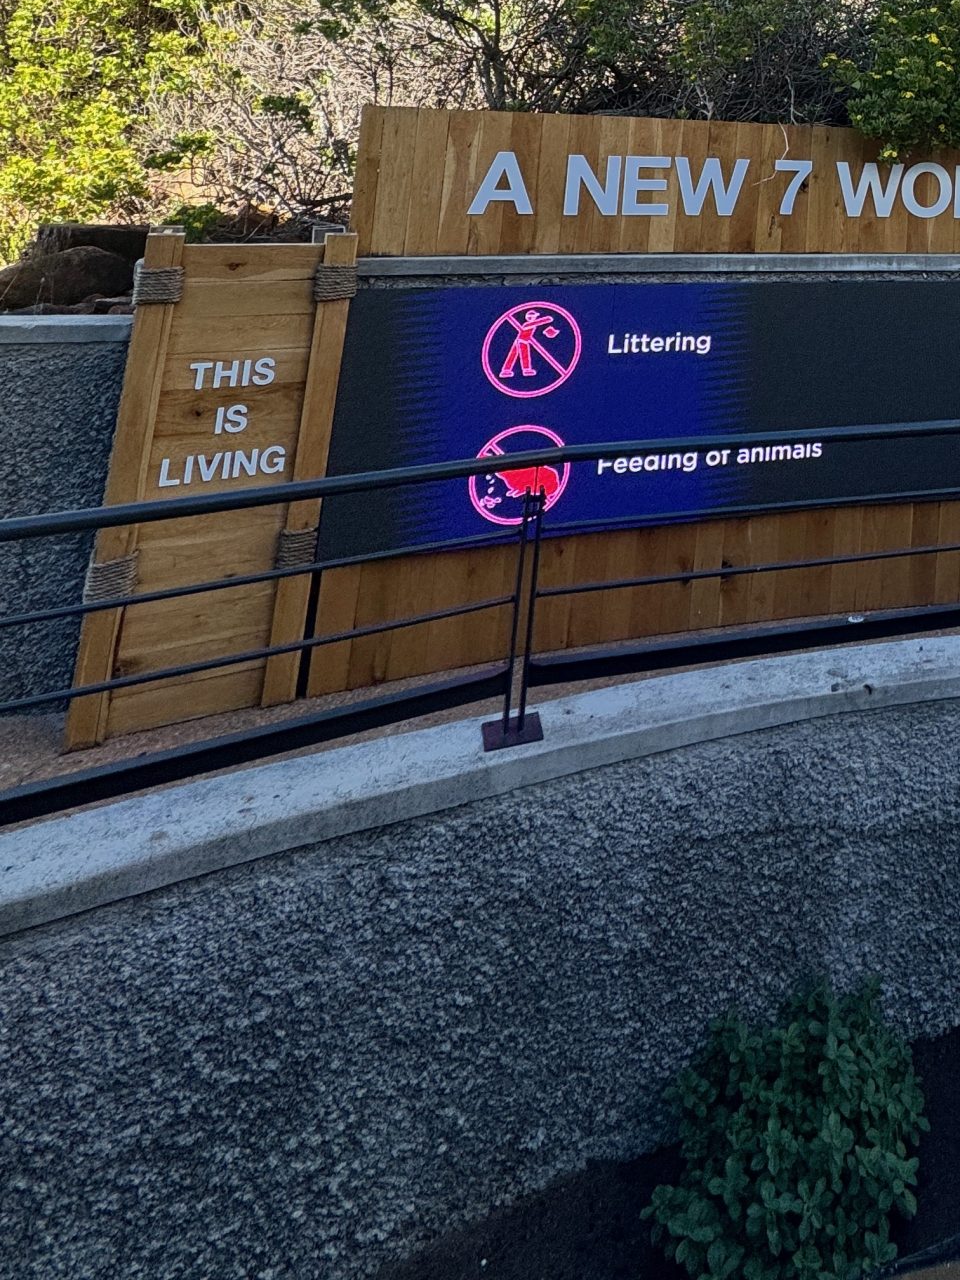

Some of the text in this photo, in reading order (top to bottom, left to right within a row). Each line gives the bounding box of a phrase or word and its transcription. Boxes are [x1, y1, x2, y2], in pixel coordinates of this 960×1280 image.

[466, 151, 534, 215] A
[563, 154, 750, 216] NEW
[774, 159, 813, 215] 7
[607, 332, 711, 354] Littering
[189, 357, 276, 391] THIS
[214, 404, 248, 435] IS
[158, 445, 286, 488] LIVING
